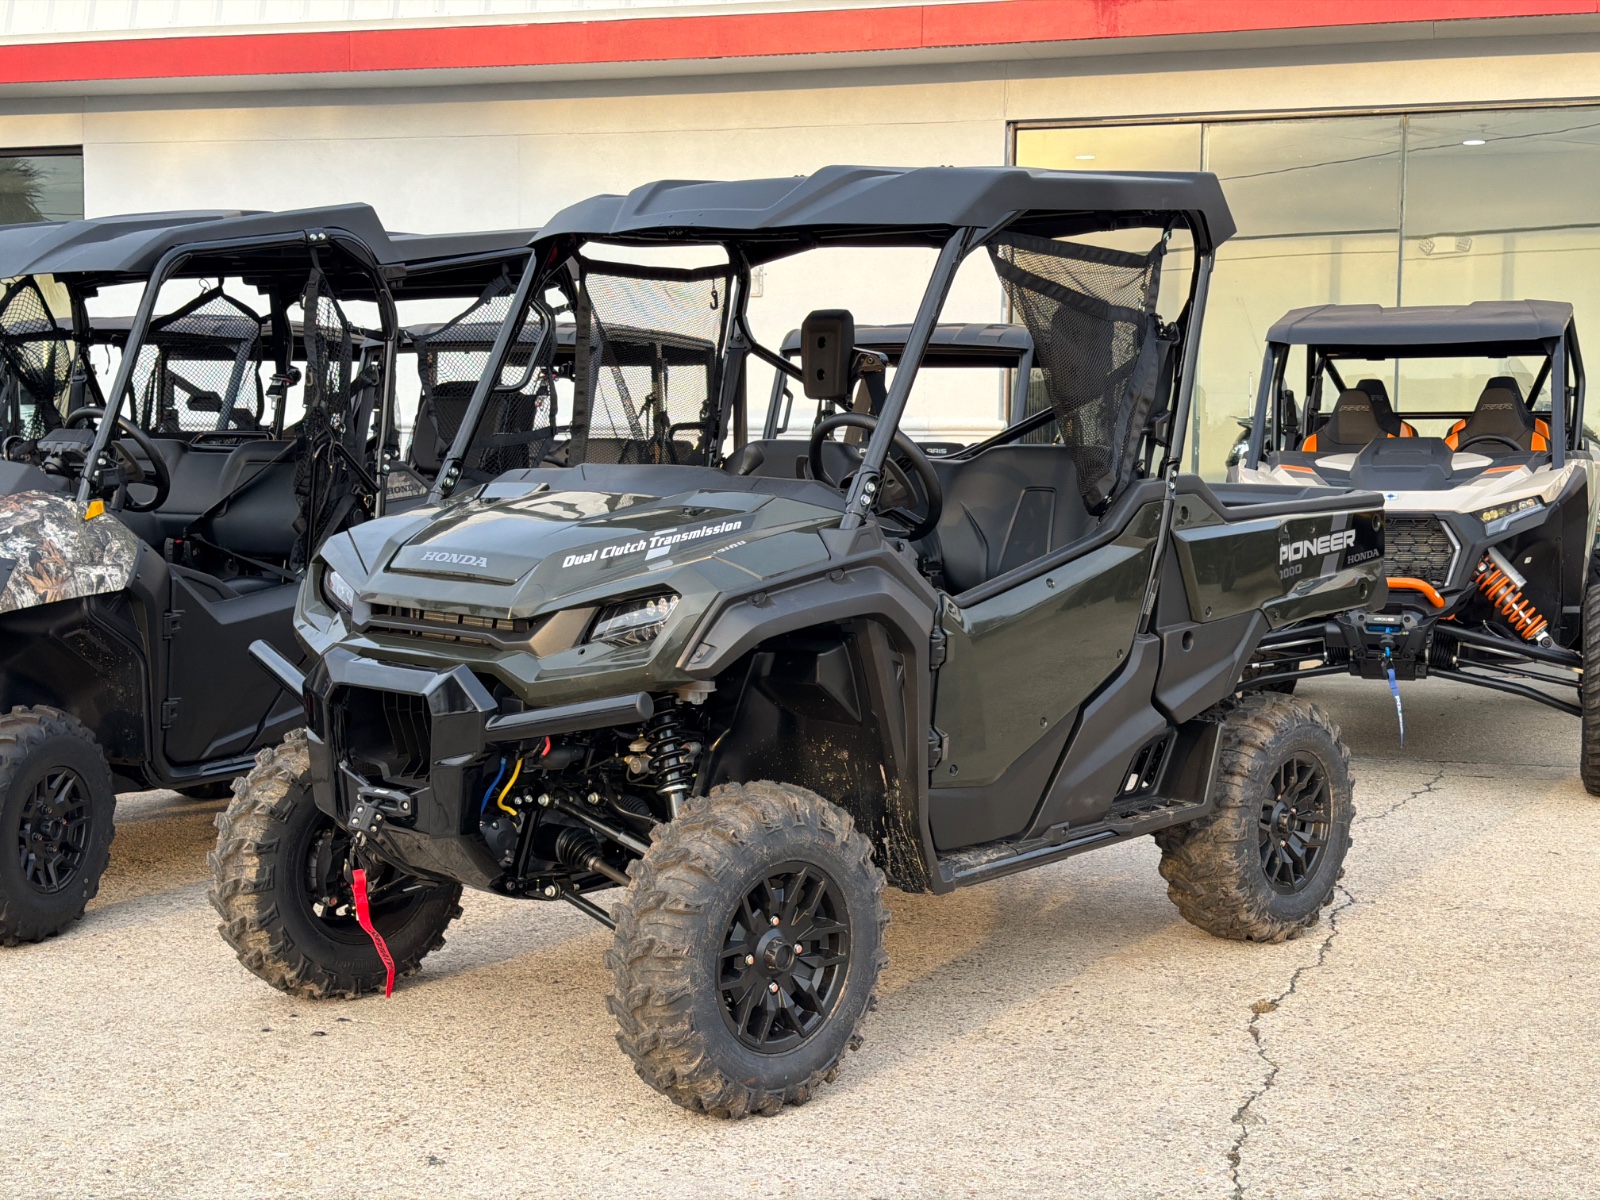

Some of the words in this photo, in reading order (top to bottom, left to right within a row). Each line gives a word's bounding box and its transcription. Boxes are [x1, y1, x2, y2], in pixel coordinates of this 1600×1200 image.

[387, 484, 422, 494] HONDA
[562, 550, 597, 568] Dual
[600, 540, 647, 560] Clutch
[649, 520, 743, 548] Transmission
[1280, 529, 1356, 565] PIONEER
[420, 551, 488, 568] HONDA
[1347, 548, 1380, 564] HONDA
[1280, 564, 1303, 580] 1000
